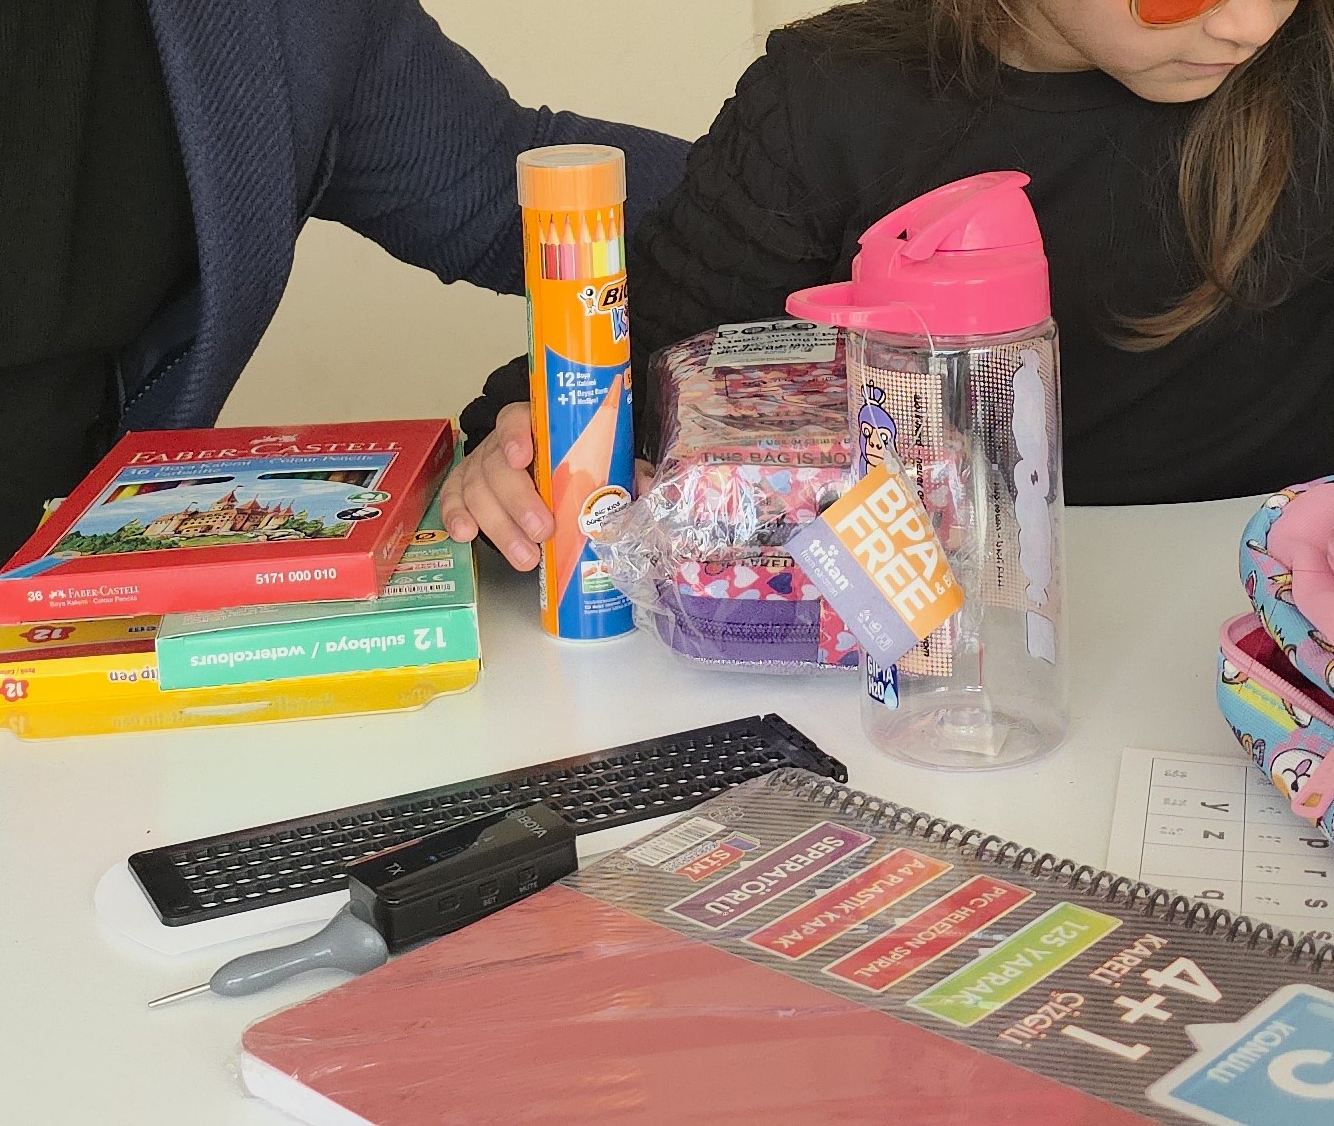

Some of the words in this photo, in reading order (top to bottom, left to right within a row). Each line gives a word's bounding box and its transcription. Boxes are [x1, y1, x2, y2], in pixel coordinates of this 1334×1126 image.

[557, 371, 576, 387] 12
[558, 389, 576, 405] +1
[129, 441, 403, 464] FABER-CASTELL
[701, 452, 744, 462] THIS
[750, 452, 791, 463] BAG
[797, 452, 814, 464] IS
[818, 452, 851, 464] NO
[865, 478, 938, 579] BPA
[800, 549, 815, 571] from
[808, 539, 849, 591] tritan
[835, 505, 937, 622] FREE
[256, 572, 284, 585] 5171
[288, 570, 311, 582] 000
[314, 568, 337, 581] 010
[27, 591, 43, 602] 36
[68, 585, 139, 600] FABER-CASTELL
[33, 628, 63, 640] 12
[326, 634, 406, 653] suluboya
[414, 627, 446, 650] 12
[190, 645, 306, 668] watercolours
[109, 671, 138, 683] Pen
[140, 666, 158, 682] ip
[4, 681, 24, 697] 12
[868, 676, 885, 701] H2O
[1200, 802, 1230, 812] y
[518, 815, 548, 839] BOYA
[1203, 830, 1225, 840] z
[1299, 837, 1330, 849] p
[386, 862, 406, 876] TX
[684, 850, 732, 875] SİM
[902, 858, 924, 878] A4
[1304, 869, 1327, 878] r
[705, 835, 845, 917] SEPERATÖRLÜ
[840, 871, 903, 914] PLASTİK
[973, 886, 1007, 908] PVC
[1305, 898, 1328, 909] s
[772, 903, 845, 949] KAPAK
[910, 905, 976, 947] HELEZON
[1040, 920, 1090, 946] 125
[854, 943, 913, 978] SPİRAL
[1089, 933, 1168, 987] KARELİ
[951, 946, 1051, 1007] YAPRAK
[998, 990, 1085, 1048] ÇİZGİLİ
[1061, 957, 1222, 1061] 4+1
[1206, 1021, 1295, 1083] KONULU
